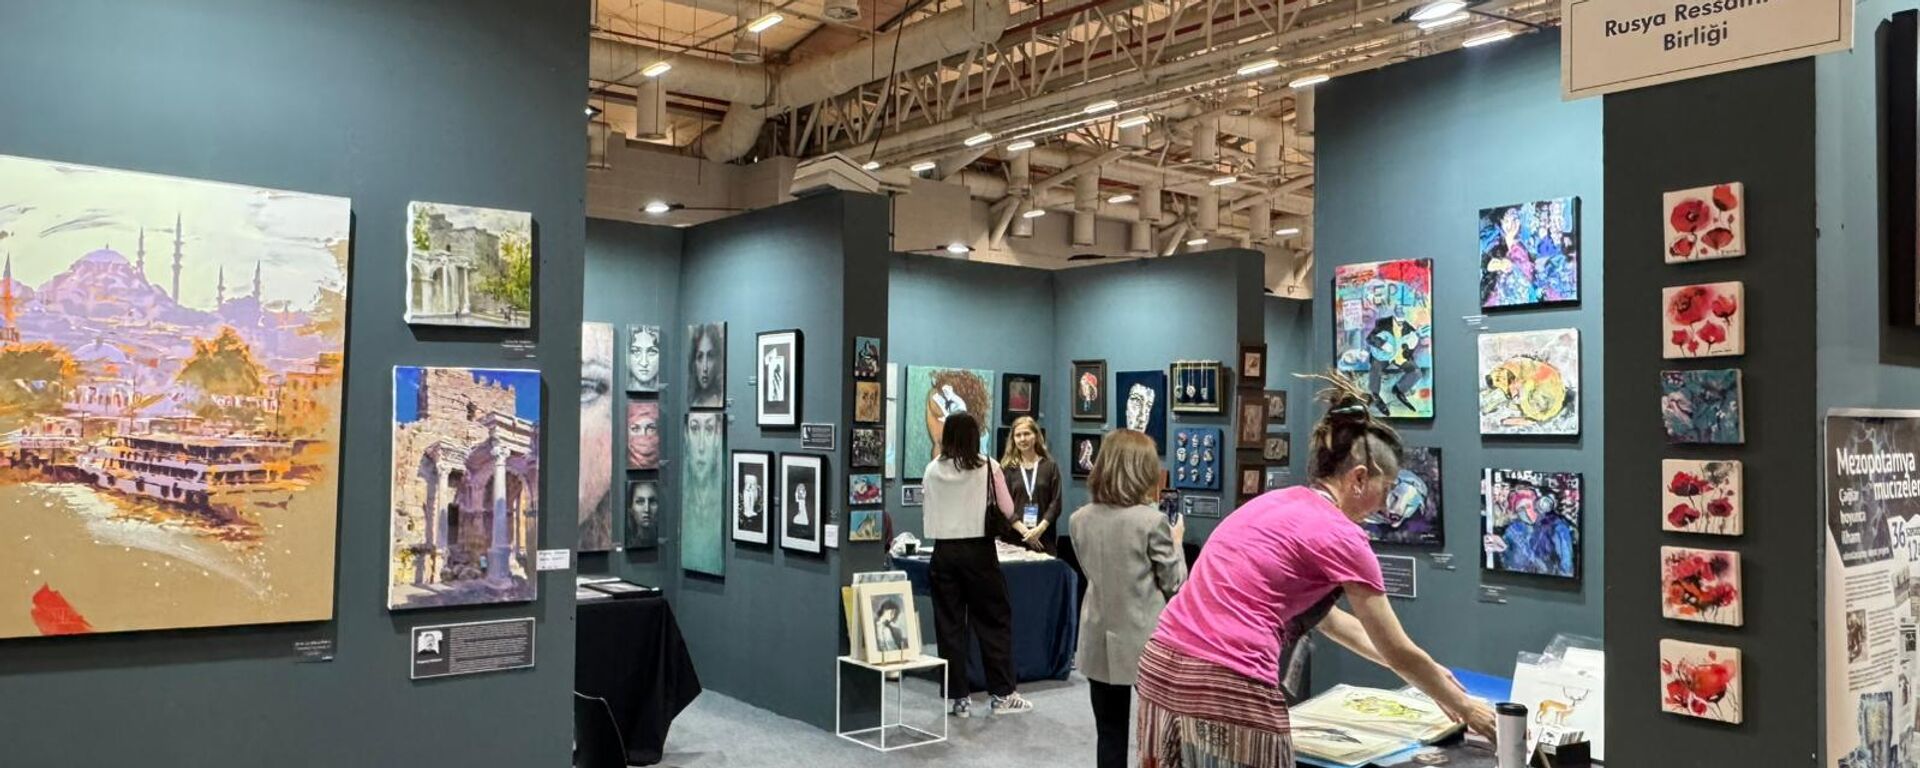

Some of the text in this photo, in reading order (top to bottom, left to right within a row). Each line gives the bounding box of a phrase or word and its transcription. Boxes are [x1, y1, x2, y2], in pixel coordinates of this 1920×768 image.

[1605, 13, 1666, 37] Rusya
[1664, 21, 1728, 51] Birliği
[1836, 447, 1917, 481] Mezopotamya
